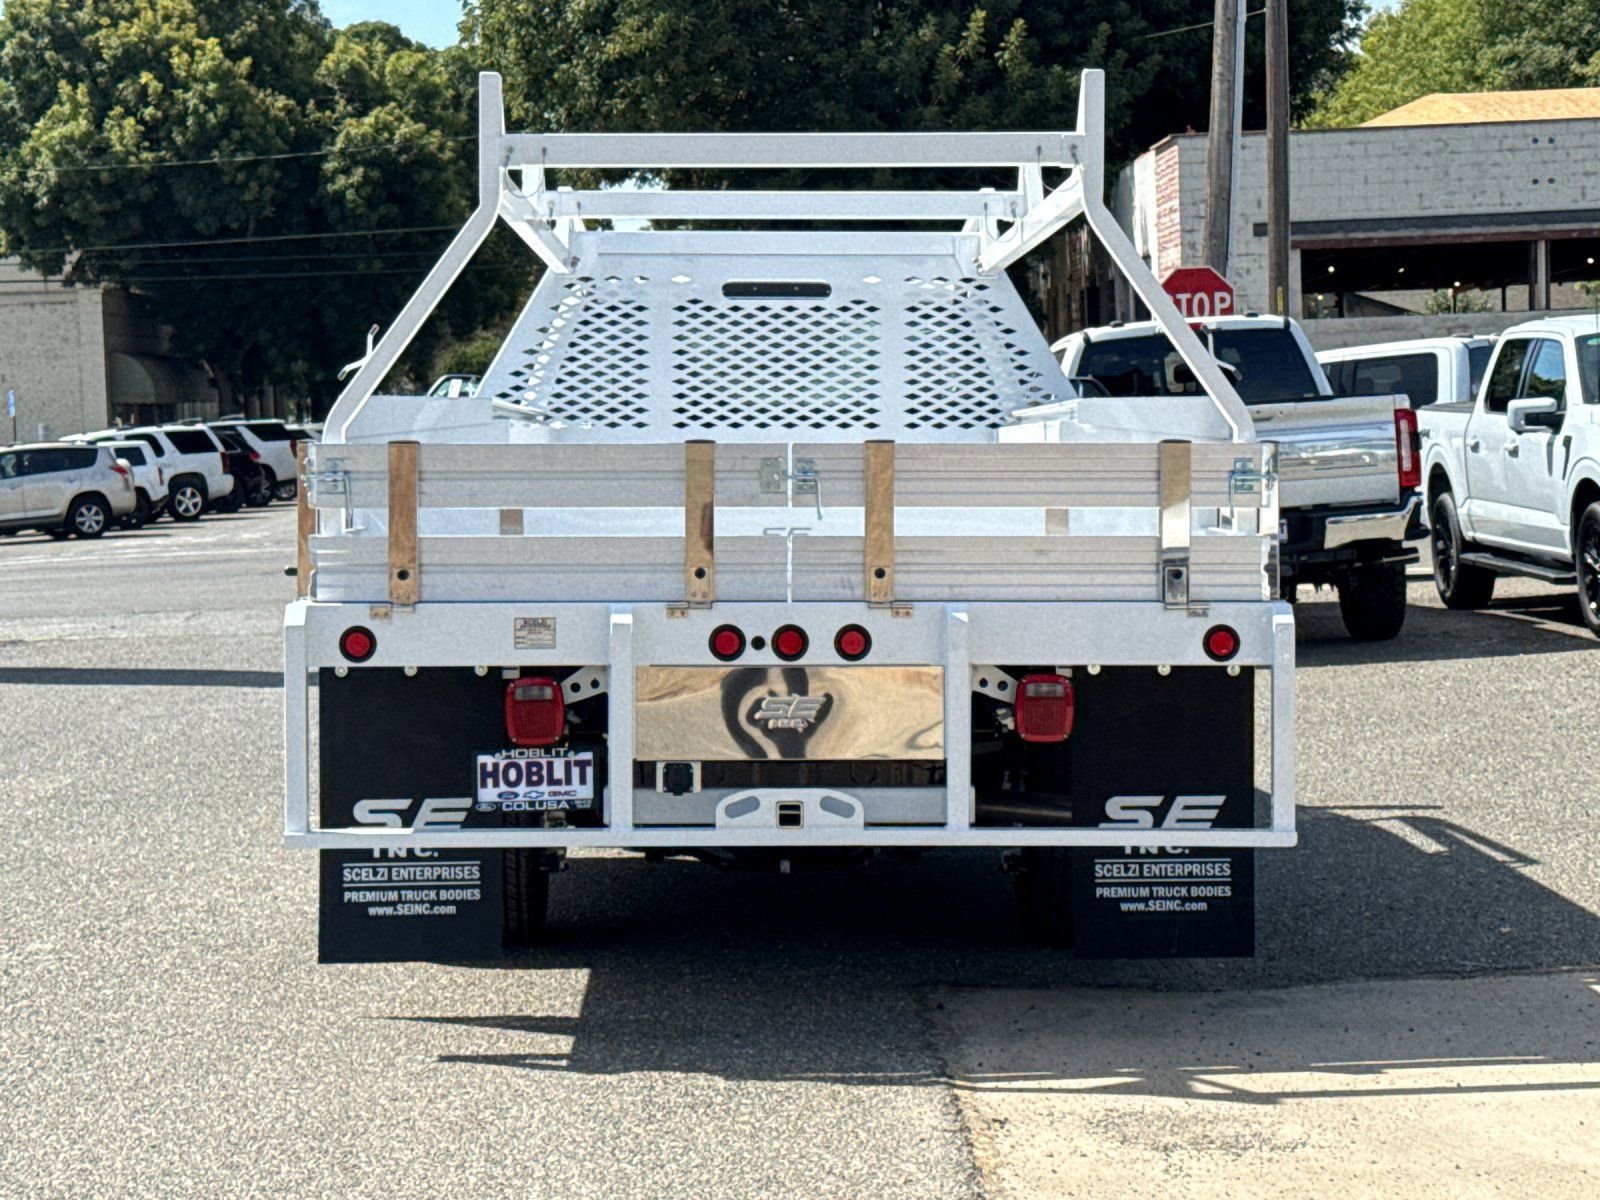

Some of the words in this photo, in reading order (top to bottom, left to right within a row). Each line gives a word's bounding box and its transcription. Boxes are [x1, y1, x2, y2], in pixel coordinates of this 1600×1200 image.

[1168, 292, 1231, 317] TOP
[501, 748, 568, 759] HOBLIT
[480, 760, 592, 788] HOBLIT
[502, 801, 570, 811] COLUSA
[342, 867, 389, 881] SCELZI
[391, 866, 481, 880] ENTERPRISES
[1094, 863, 1140, 877] SCELZI
[1143, 862, 1232, 876] ENTERPRISES
[343, 890, 398, 902] PREMIUM
[400, 889, 437, 901] TRUCK
[439, 889, 481, 901] BODIES
[1096, 886, 1150, 898] PREMIUM
[1152, 886, 1189, 897] TRUCK
[1190, 885, 1232, 897] BODIES
[367, 903, 457, 916] www.SEINC.com
[1119, 900, 1208, 912] www.SEINC.com
